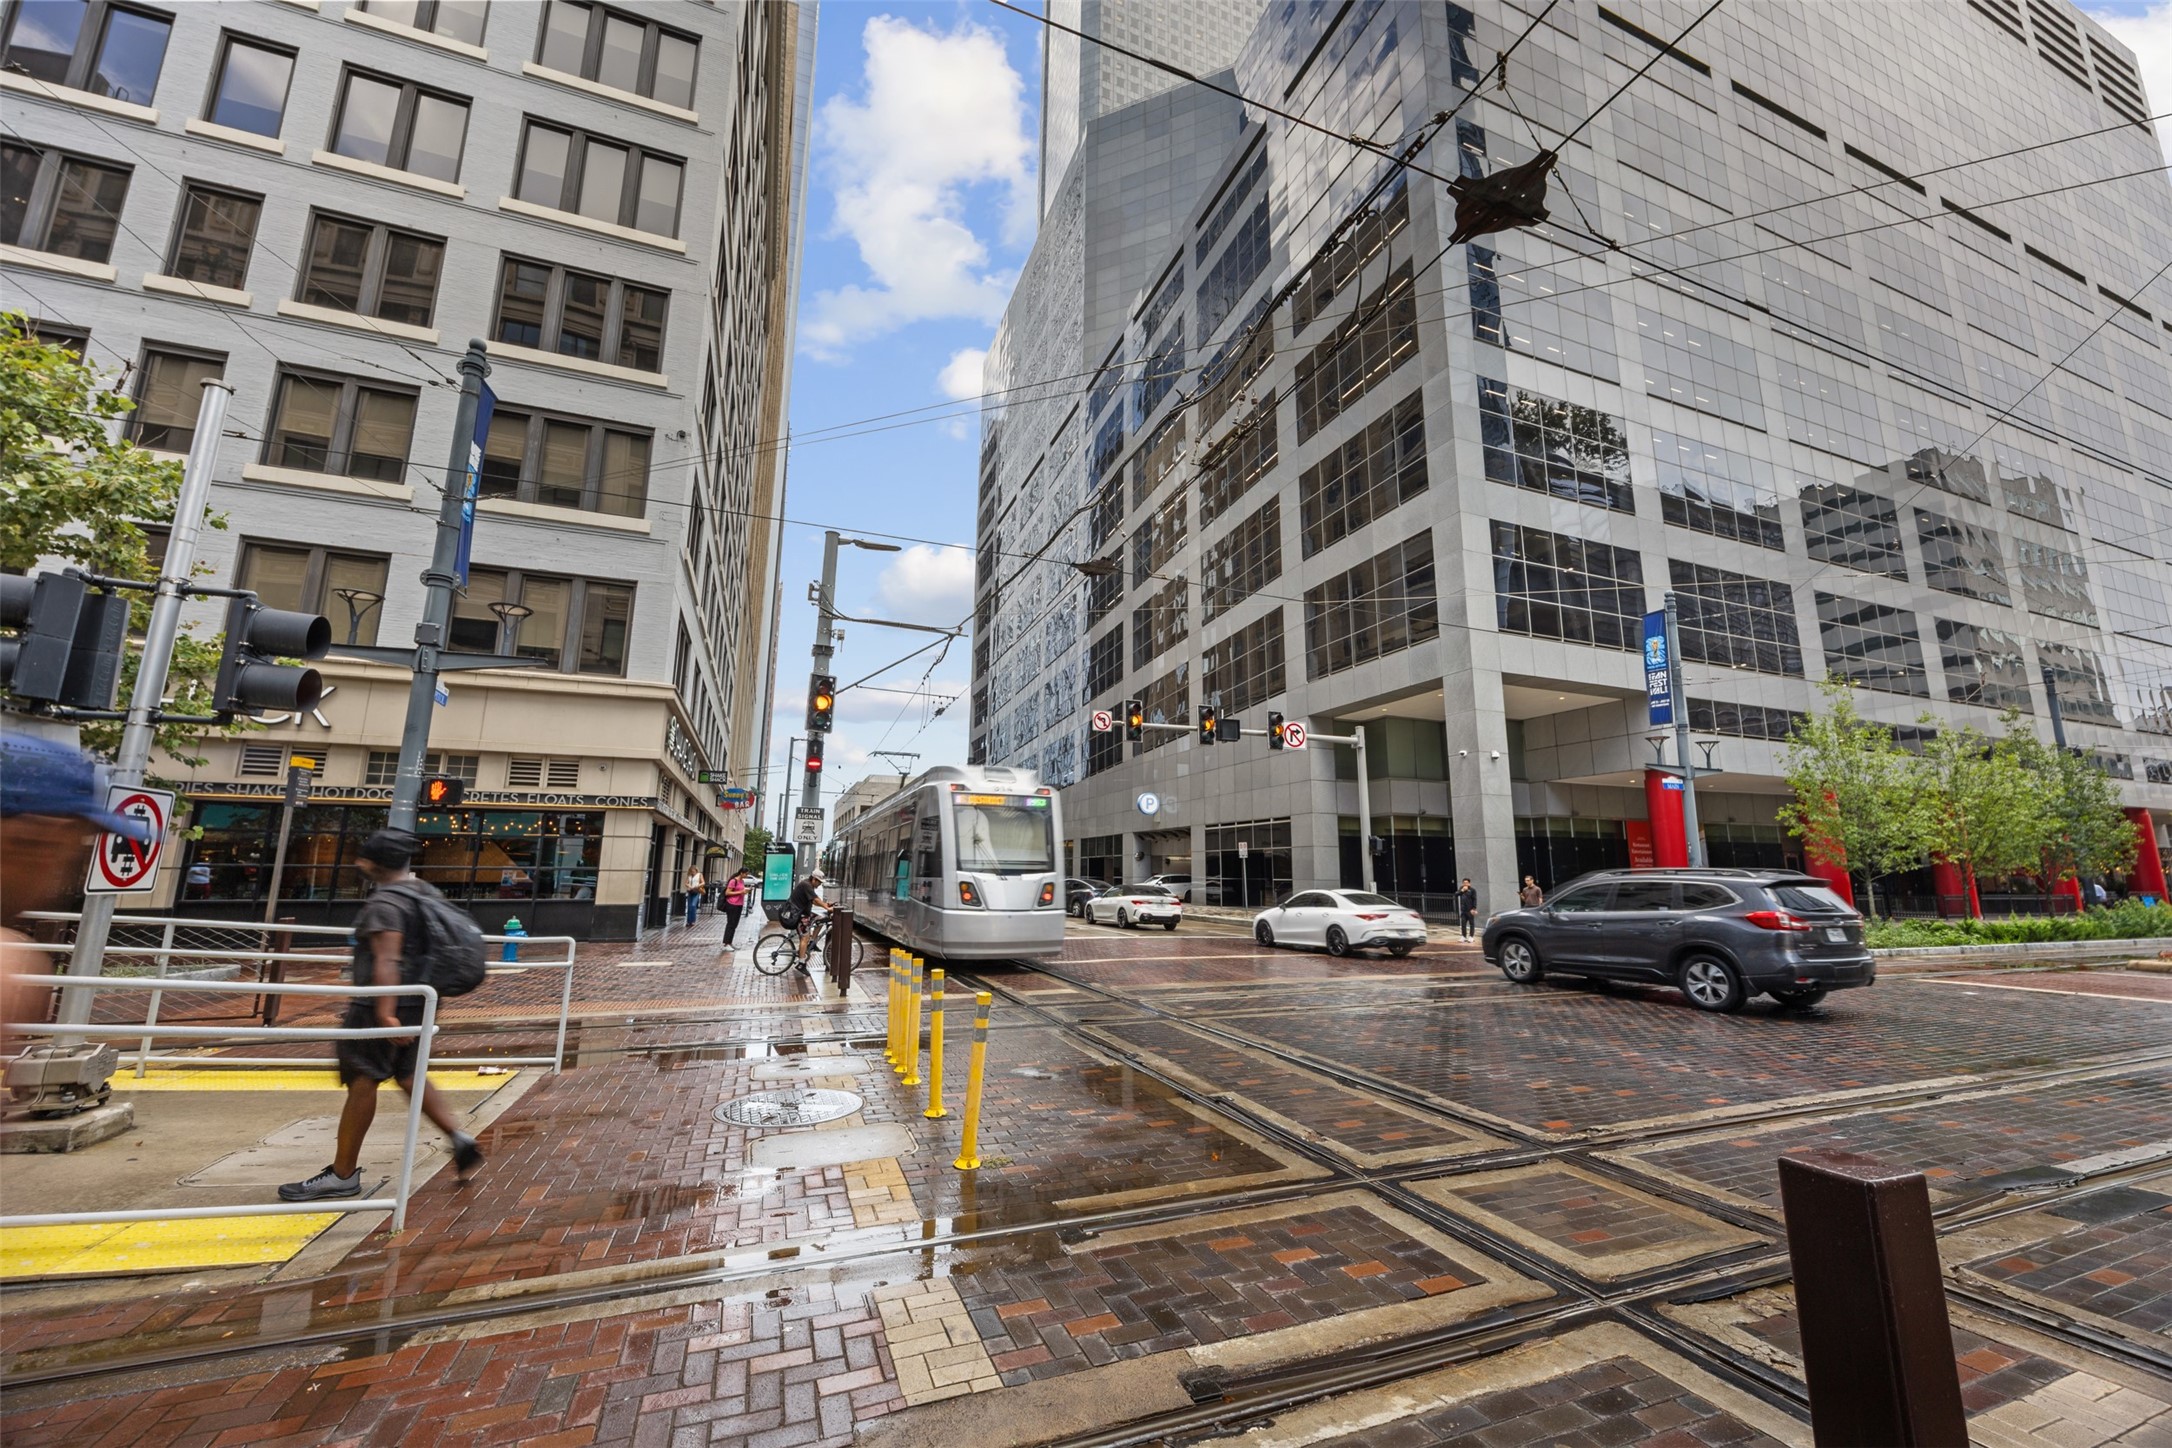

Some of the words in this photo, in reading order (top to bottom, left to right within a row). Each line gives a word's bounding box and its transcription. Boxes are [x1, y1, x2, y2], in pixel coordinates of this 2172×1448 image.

[175, 782, 214, 794] RIES
[226, 784, 287, 797] SHAKE
[311, 786, 351, 799] HOT
[353, 787, 394, 800] DOG
[526, 793, 584, 806] FLOATS
[595, 796, 648, 808] CONES
[734, 800, 750, 809] BAR
[1146, 797, 1155, 810] P
